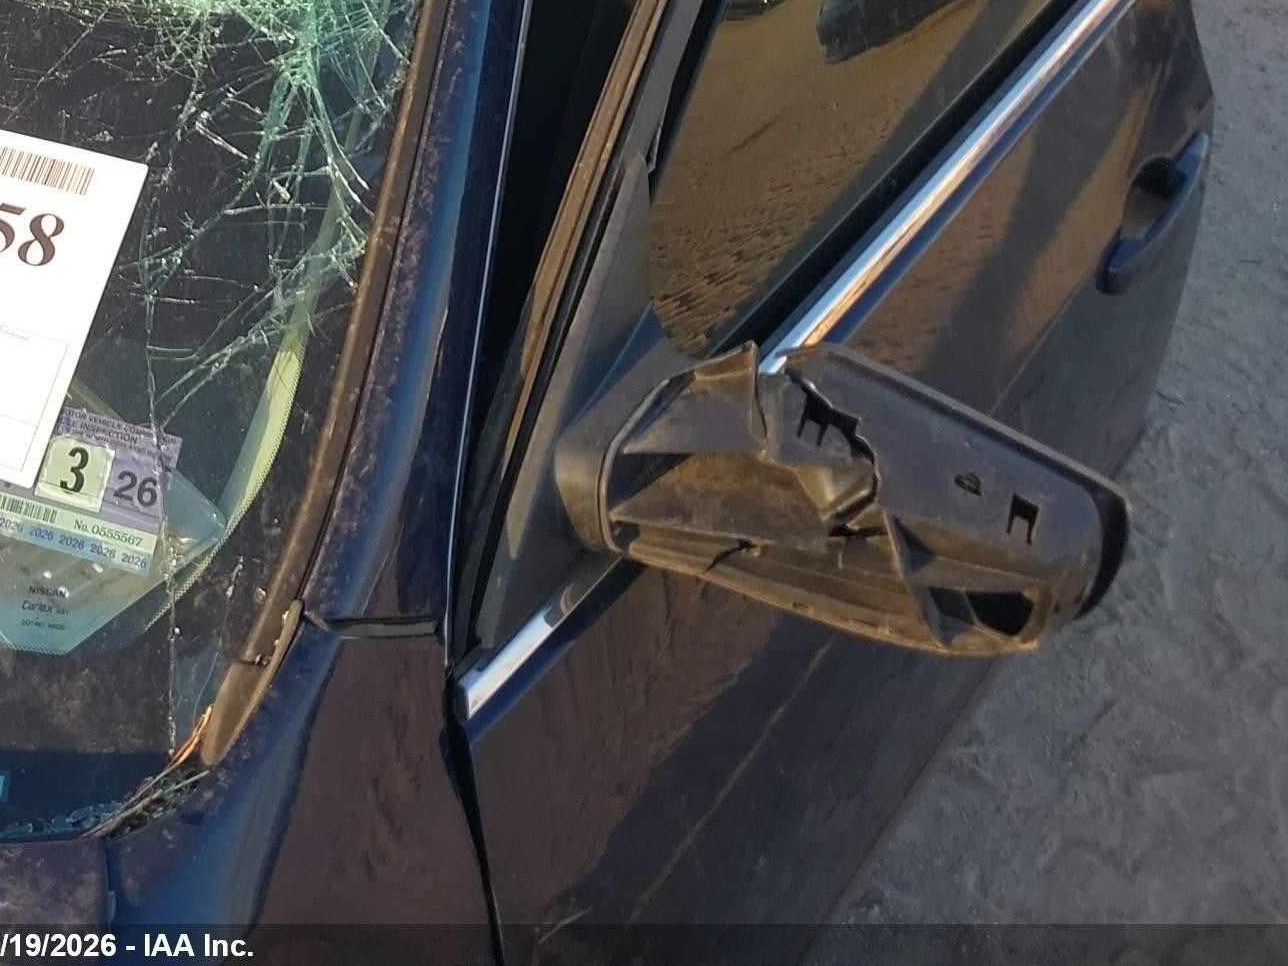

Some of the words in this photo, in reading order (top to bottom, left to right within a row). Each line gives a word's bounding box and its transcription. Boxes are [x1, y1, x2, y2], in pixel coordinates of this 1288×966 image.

[80, 421, 138, 445] INSPECTION
[89, 415, 120, 428] VEHICLE
[59, 447, 89, 493] 3
[113, 470, 158, 507] 26
[0, 517, 23, 532] 2026
[29, 525, 54, 541] 2026
[59, 534, 85, 550] 2026
[90, 543, 115, 559] 2026
[121, 553, 147, 568] 2026
[74, 519, 89, 533] No.
[92, 521, 142, 547] 0555567
